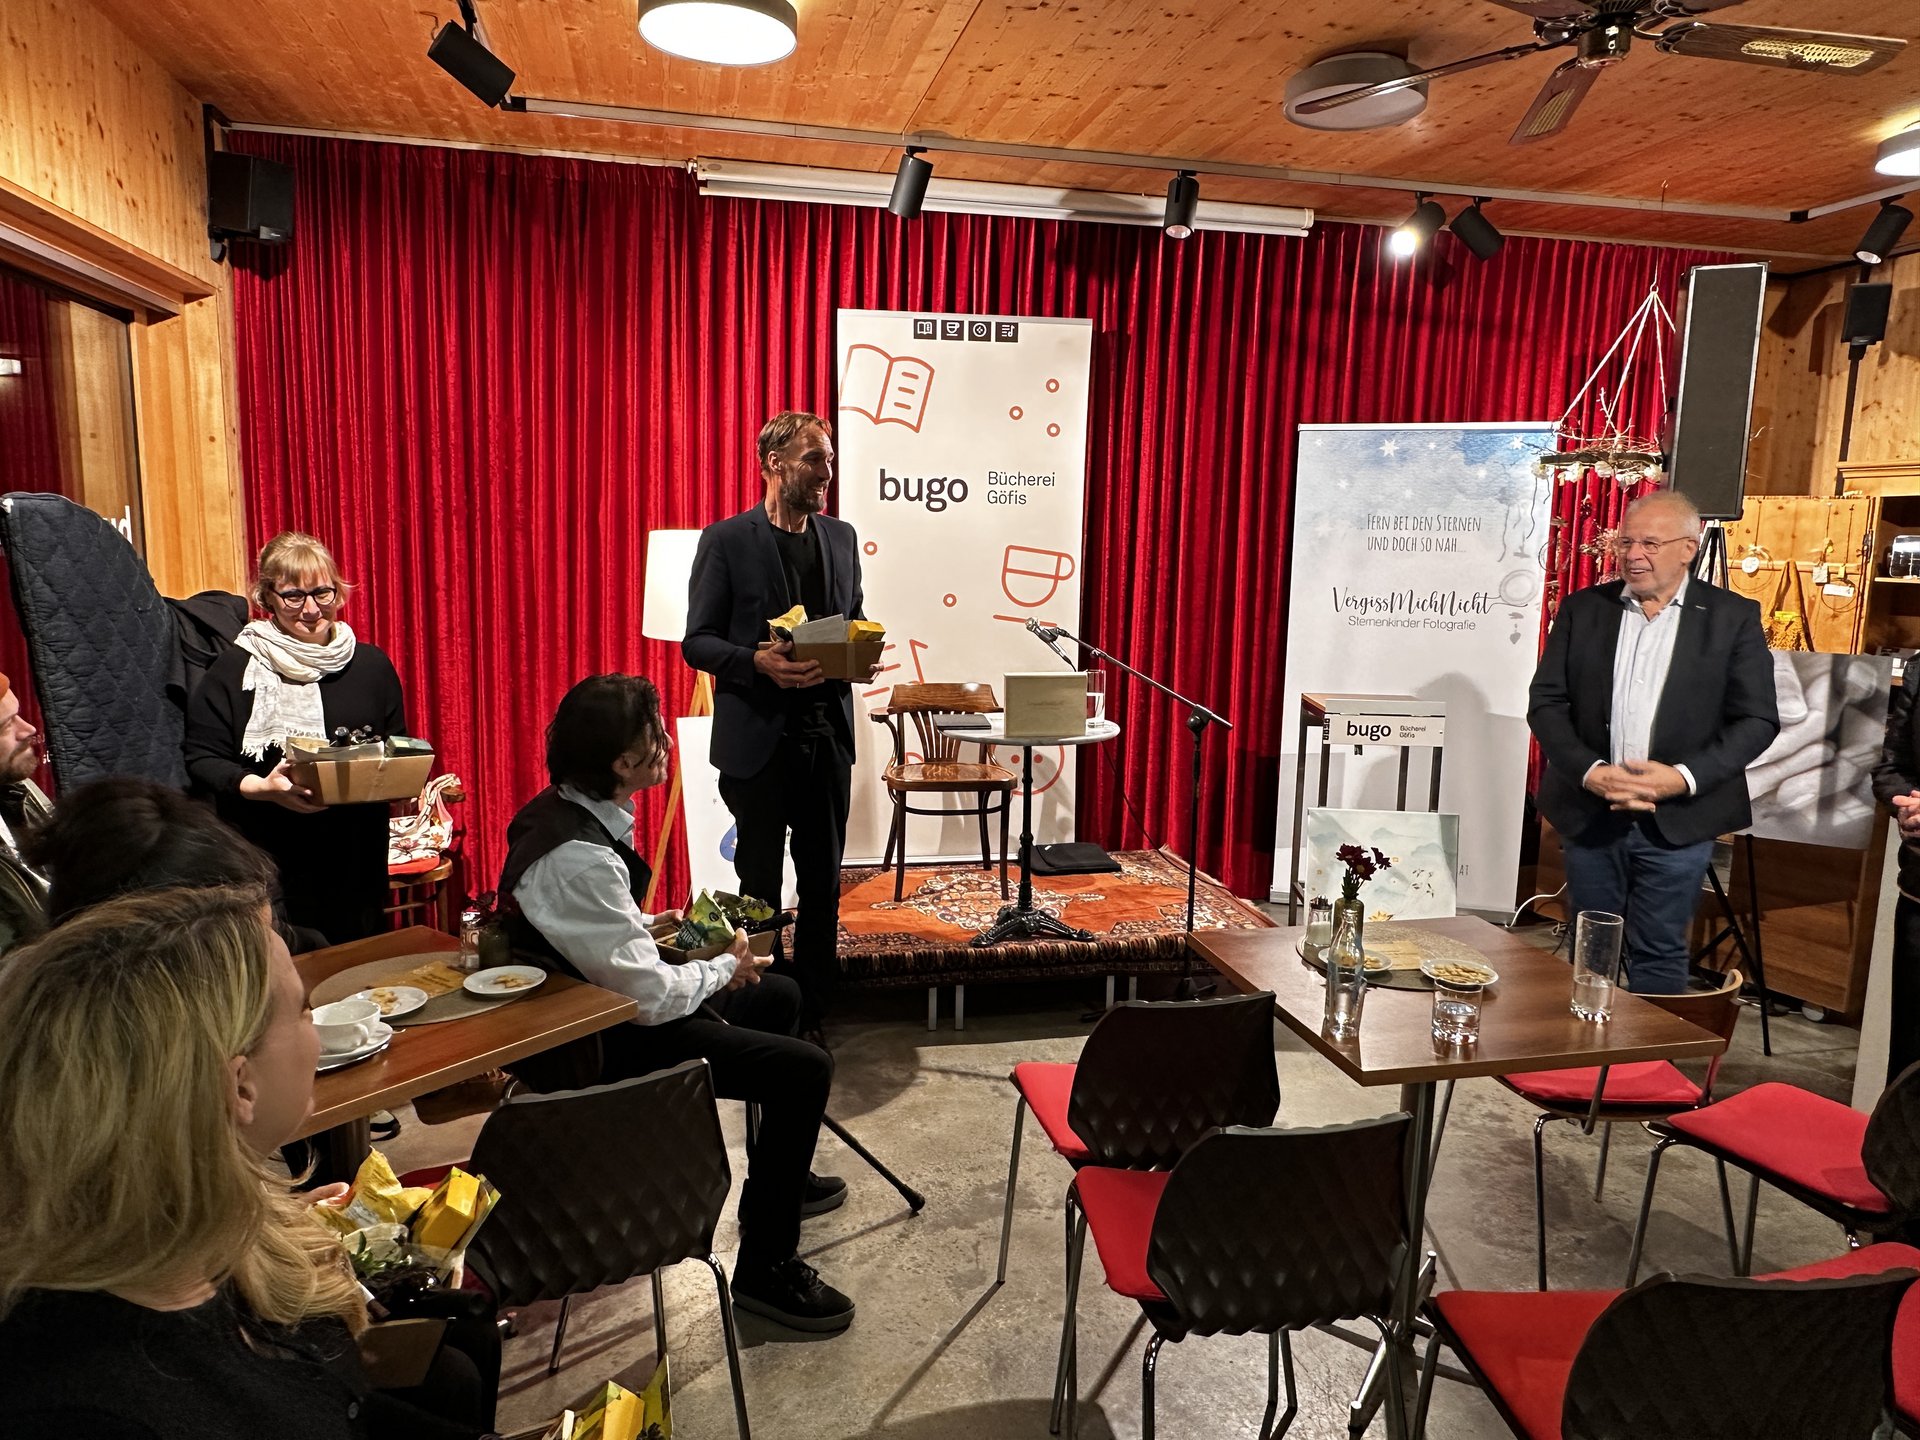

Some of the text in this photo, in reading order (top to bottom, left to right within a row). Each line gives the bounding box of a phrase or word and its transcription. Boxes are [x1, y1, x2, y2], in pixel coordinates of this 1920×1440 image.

[988, 471, 1056, 487] Bücherei
[879, 468, 969, 513] bugo
[987, 490, 1027, 505] Göfis
[1393, 515, 1409, 531] BEI
[1412, 516, 1433, 531] DEN
[1436, 514, 1482, 532] STERNEN
[1367, 536, 1389, 552] UND
[1392, 536, 1417, 552] DOCH
[1420, 537, 1432, 552] SO
[1332, 586, 1494, 616] VergissMichNicht
[1423, 618, 1476, 632] Fotografie
[1346, 720, 1392, 741] bugo
